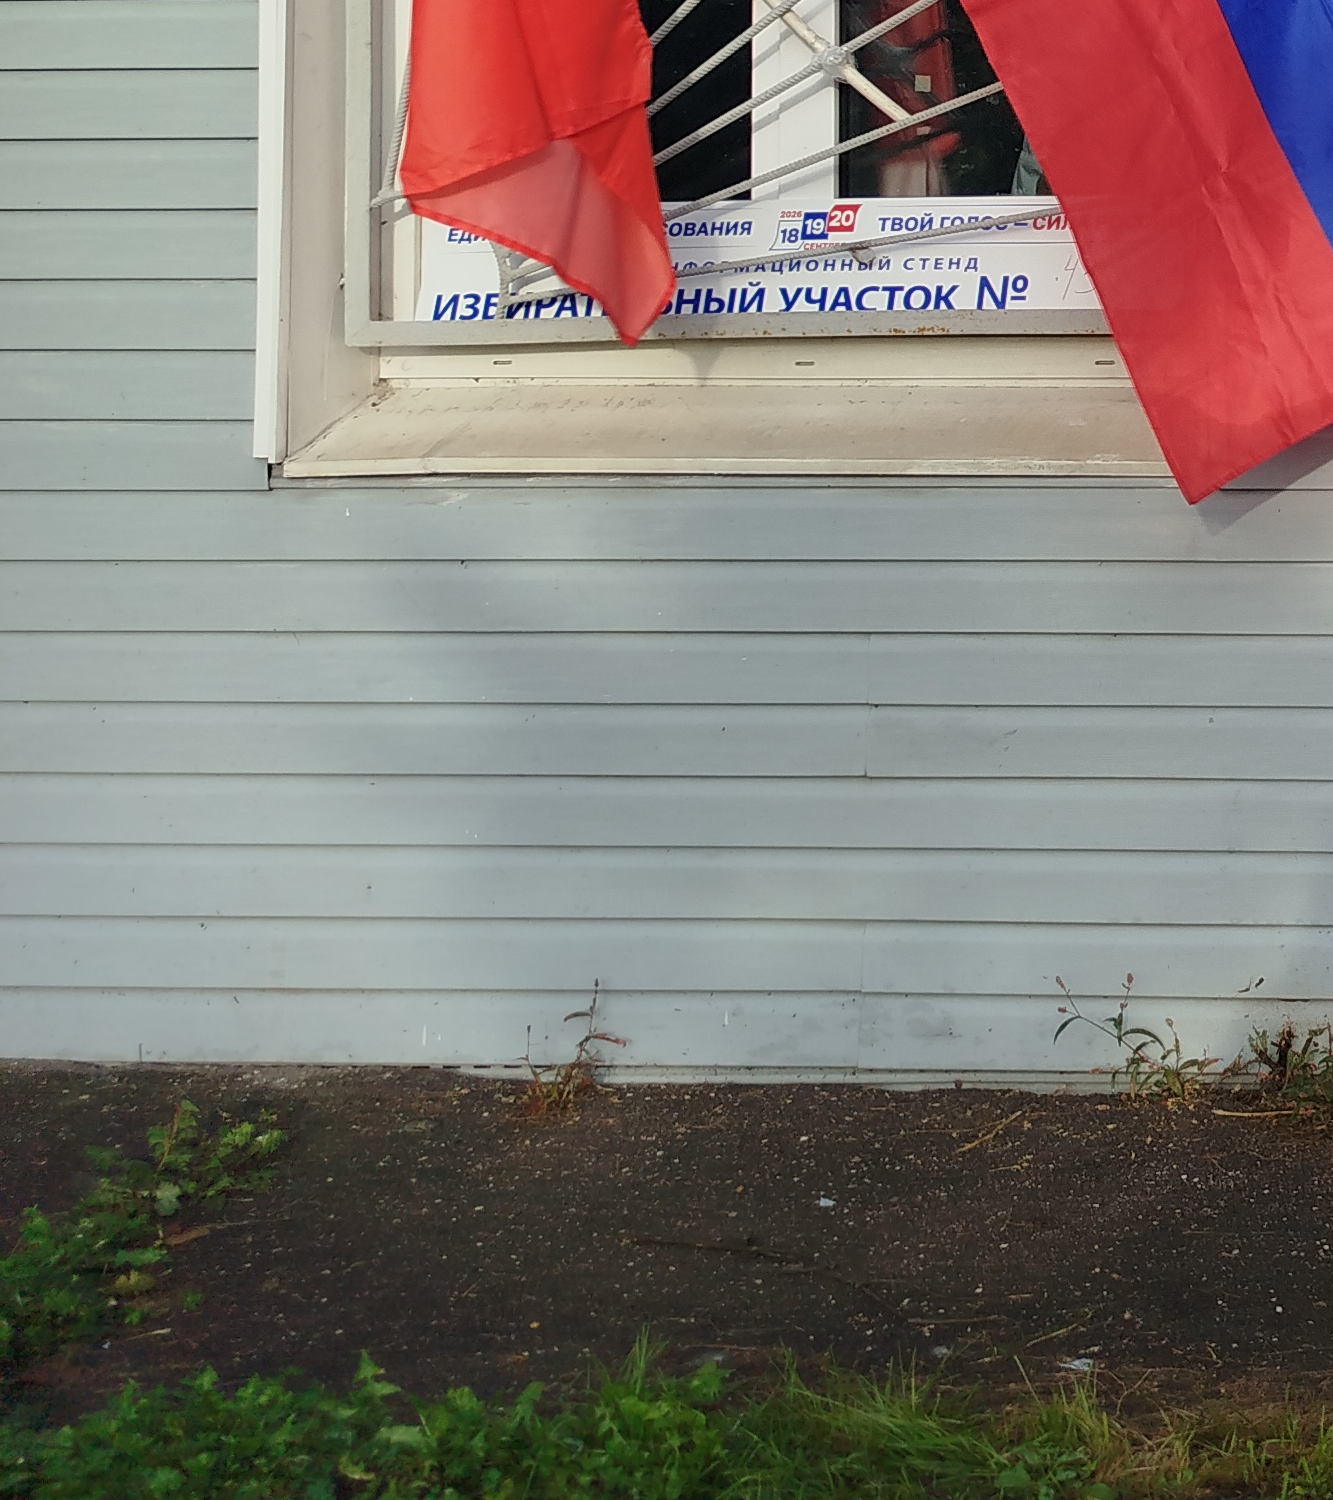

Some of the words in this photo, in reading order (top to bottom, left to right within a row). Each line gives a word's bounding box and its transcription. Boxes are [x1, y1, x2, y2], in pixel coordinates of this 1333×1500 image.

[780, 210, 803, 218] 2026
[878, 212, 934, 232] ТВОЙ
[780, 228, 800, 243] 18
[804, 218, 825, 235] 19
[828, 210, 855, 227] 20
[903, 257, 979, 272] СТЕНД
[779, 284, 961, 314] УЧАСТОК
[976, 274, 1029, 310] №
